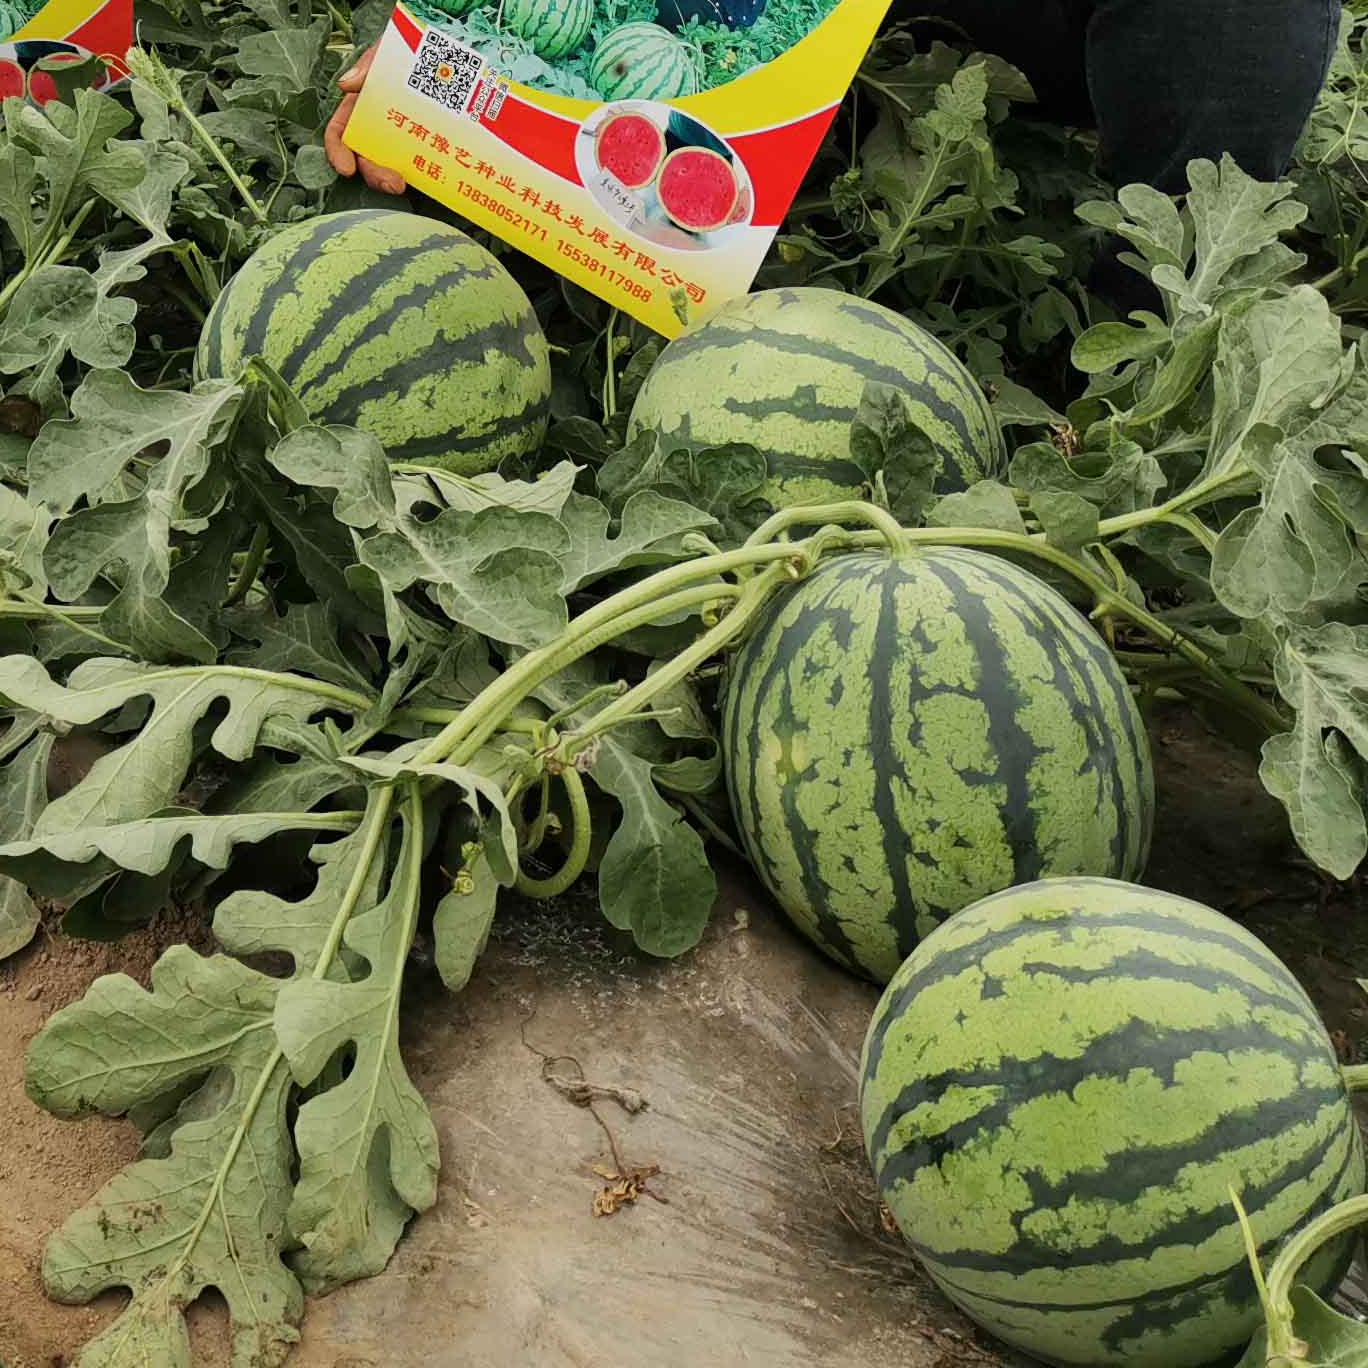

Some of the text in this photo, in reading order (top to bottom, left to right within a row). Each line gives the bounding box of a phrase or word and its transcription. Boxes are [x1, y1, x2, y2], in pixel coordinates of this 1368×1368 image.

[386, 107, 707, 305] 河南豫艺种业科技发展有限公司
[455, 180, 548, 242] 13838052171
[556, 239, 653, 303] 15538117988
